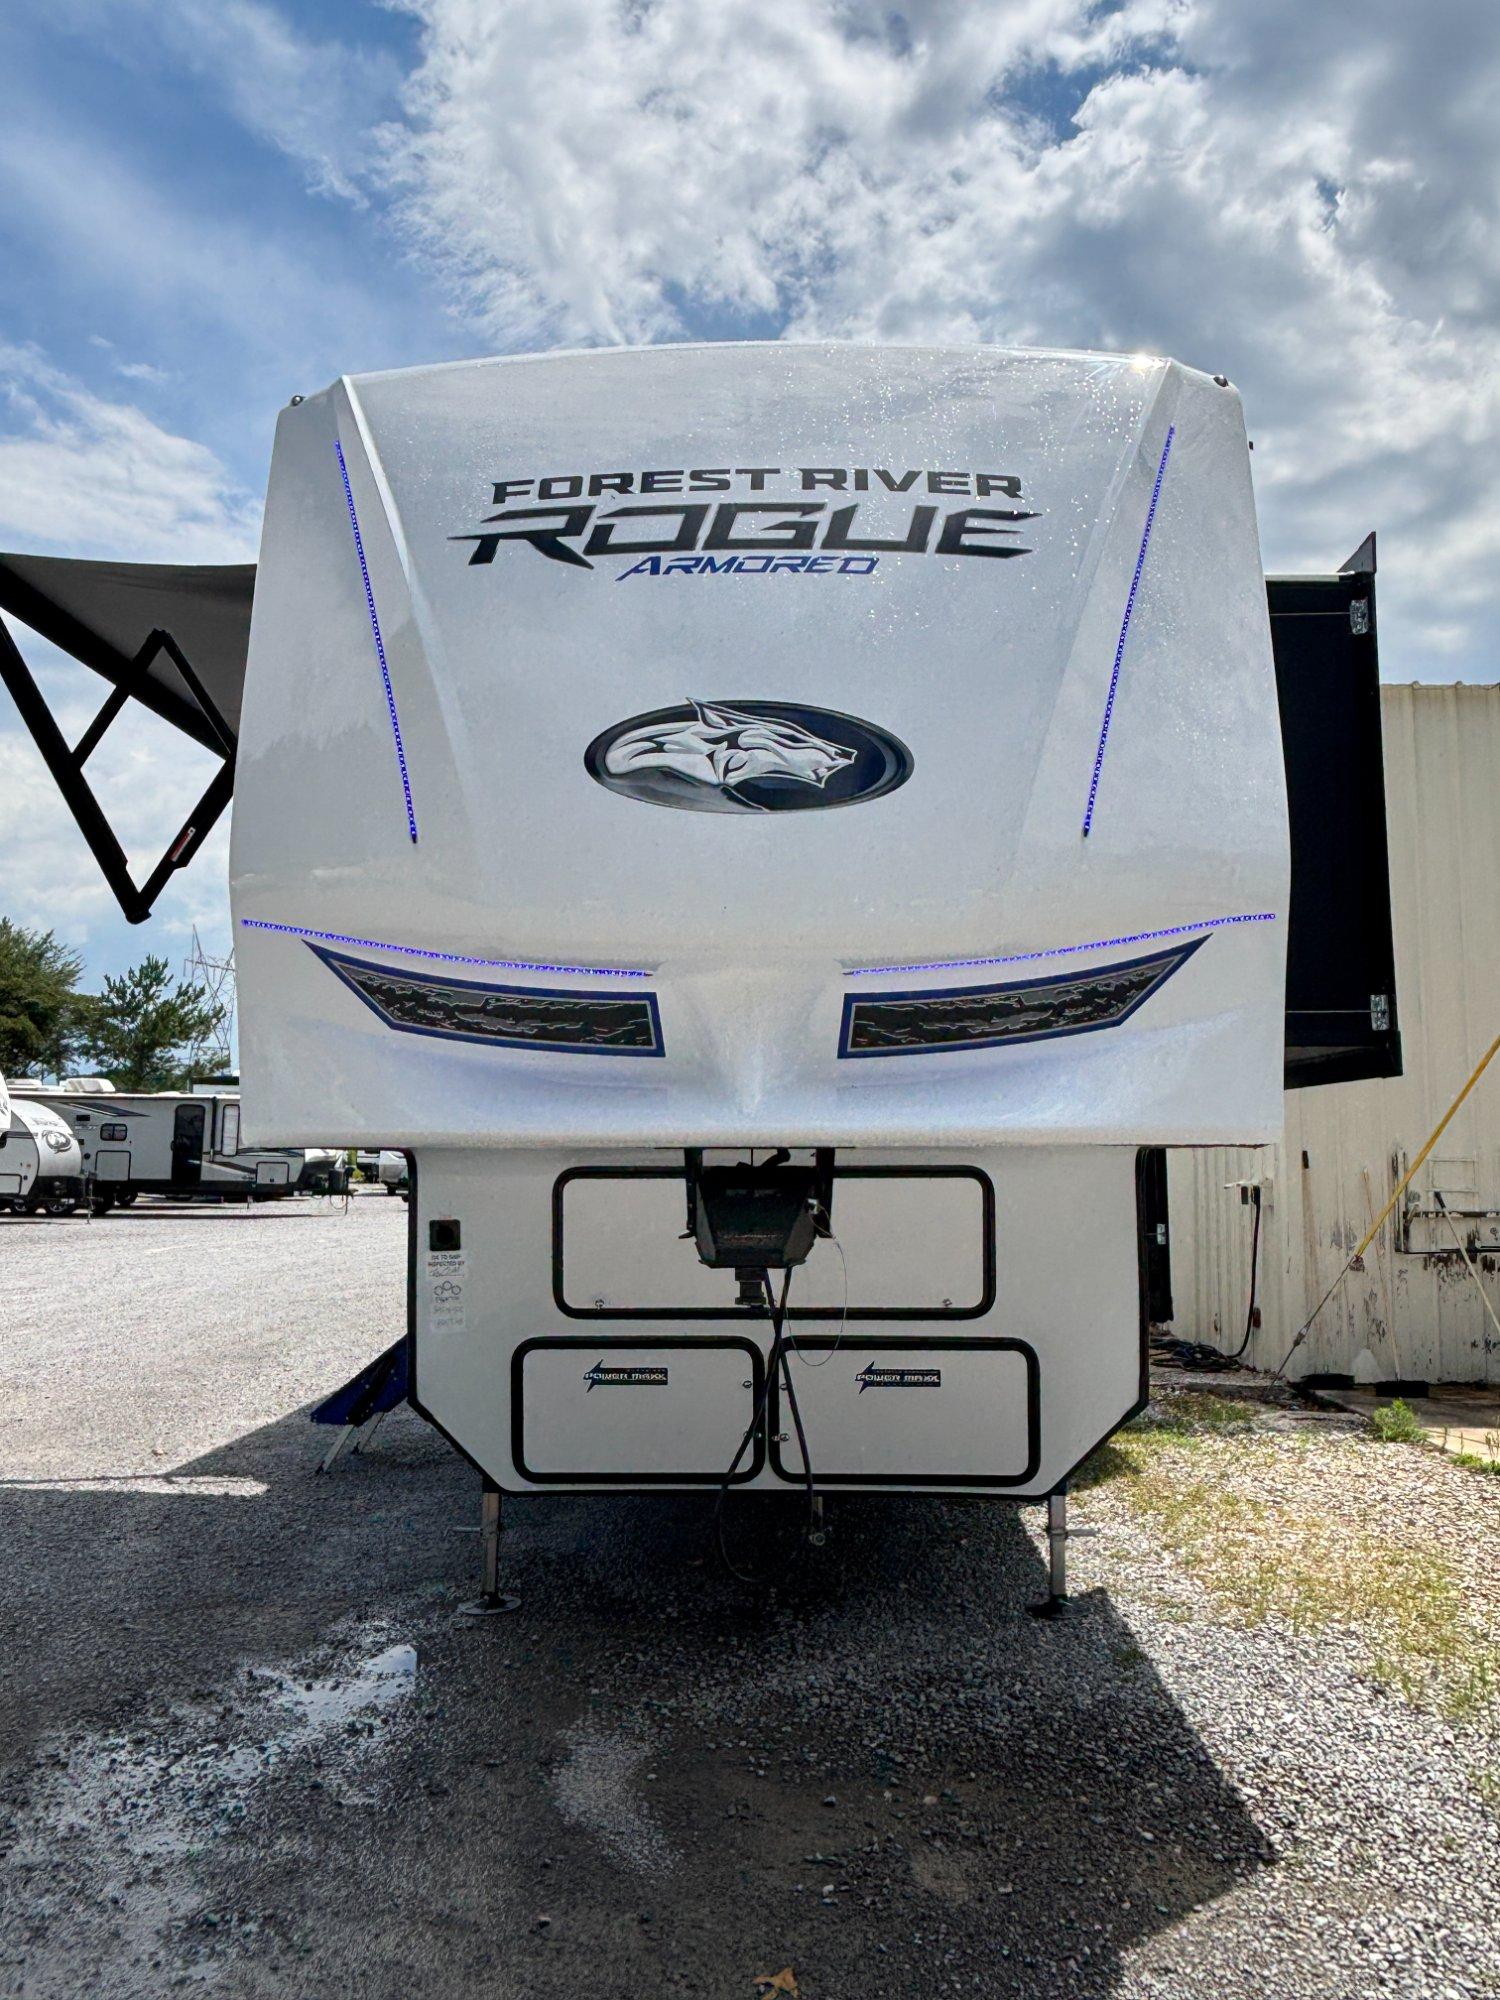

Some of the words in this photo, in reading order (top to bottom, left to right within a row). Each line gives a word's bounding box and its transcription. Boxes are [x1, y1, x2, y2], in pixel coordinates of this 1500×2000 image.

[492, 468, 781, 504] FOREST
[796, 468, 1025, 499] RIVER
[447, 503, 1044, 570] ROGUE
[615, 555, 879, 582] ARMORED
